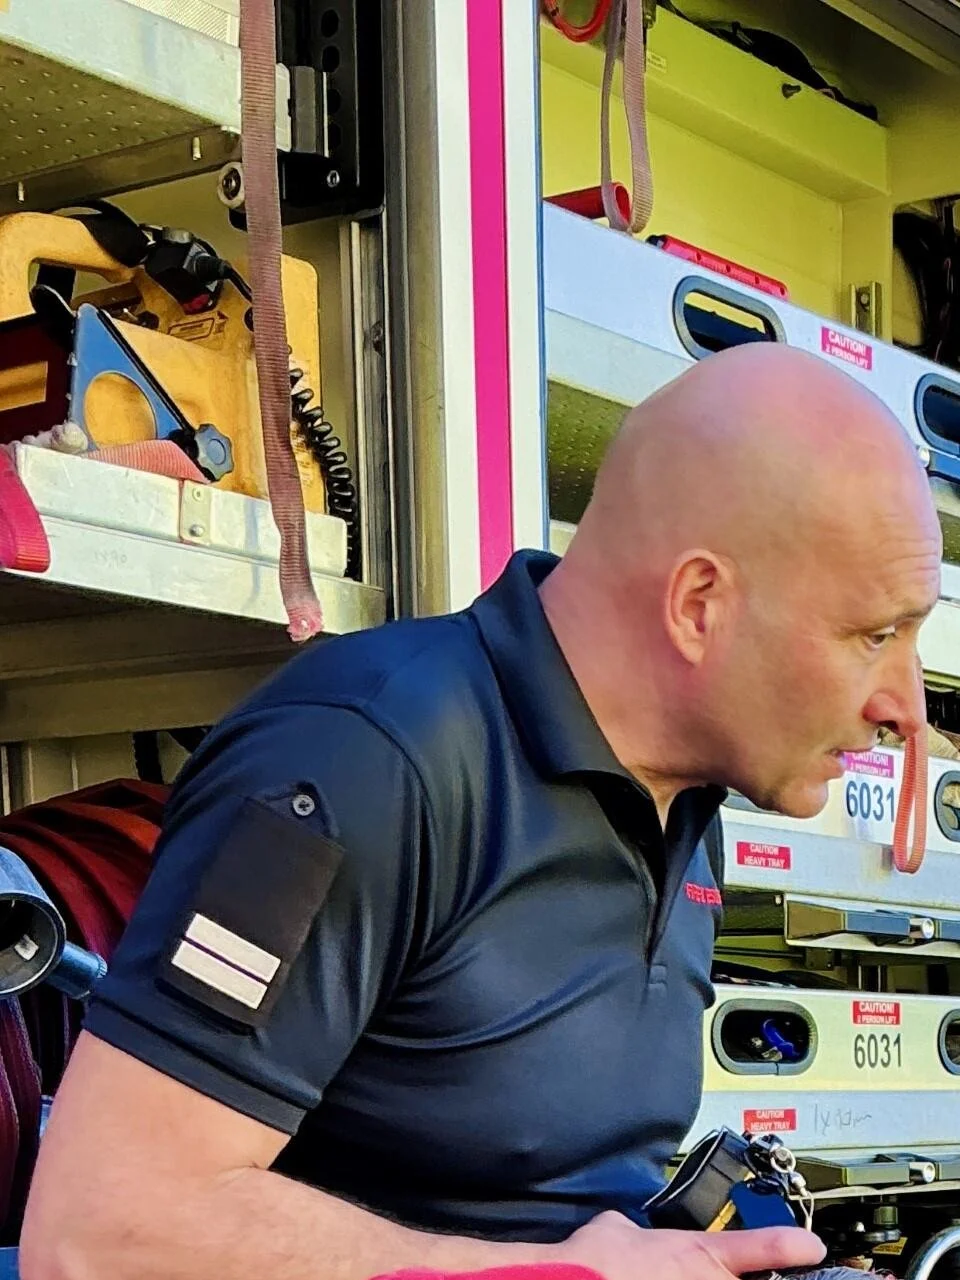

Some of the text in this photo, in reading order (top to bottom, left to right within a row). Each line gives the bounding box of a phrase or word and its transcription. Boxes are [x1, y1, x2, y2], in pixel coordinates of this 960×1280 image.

[828, 329, 867, 359] CAUTION!
[845, 780, 895, 823] 6031
[749, 843, 779, 856] CAUTION
[743, 855, 786, 868] HEAVY TRAY
[858, 1001, 895, 1014] CAUTION!
[861, 1014, 885, 1025] PERSON
[885, 1015, 898, 1025] LIFT
[854, 1033, 901, 1069] 6031
[755, 1109, 785, 1120] CAUTION
[749, 1119, 792, 1131] HEAVY TRAY
